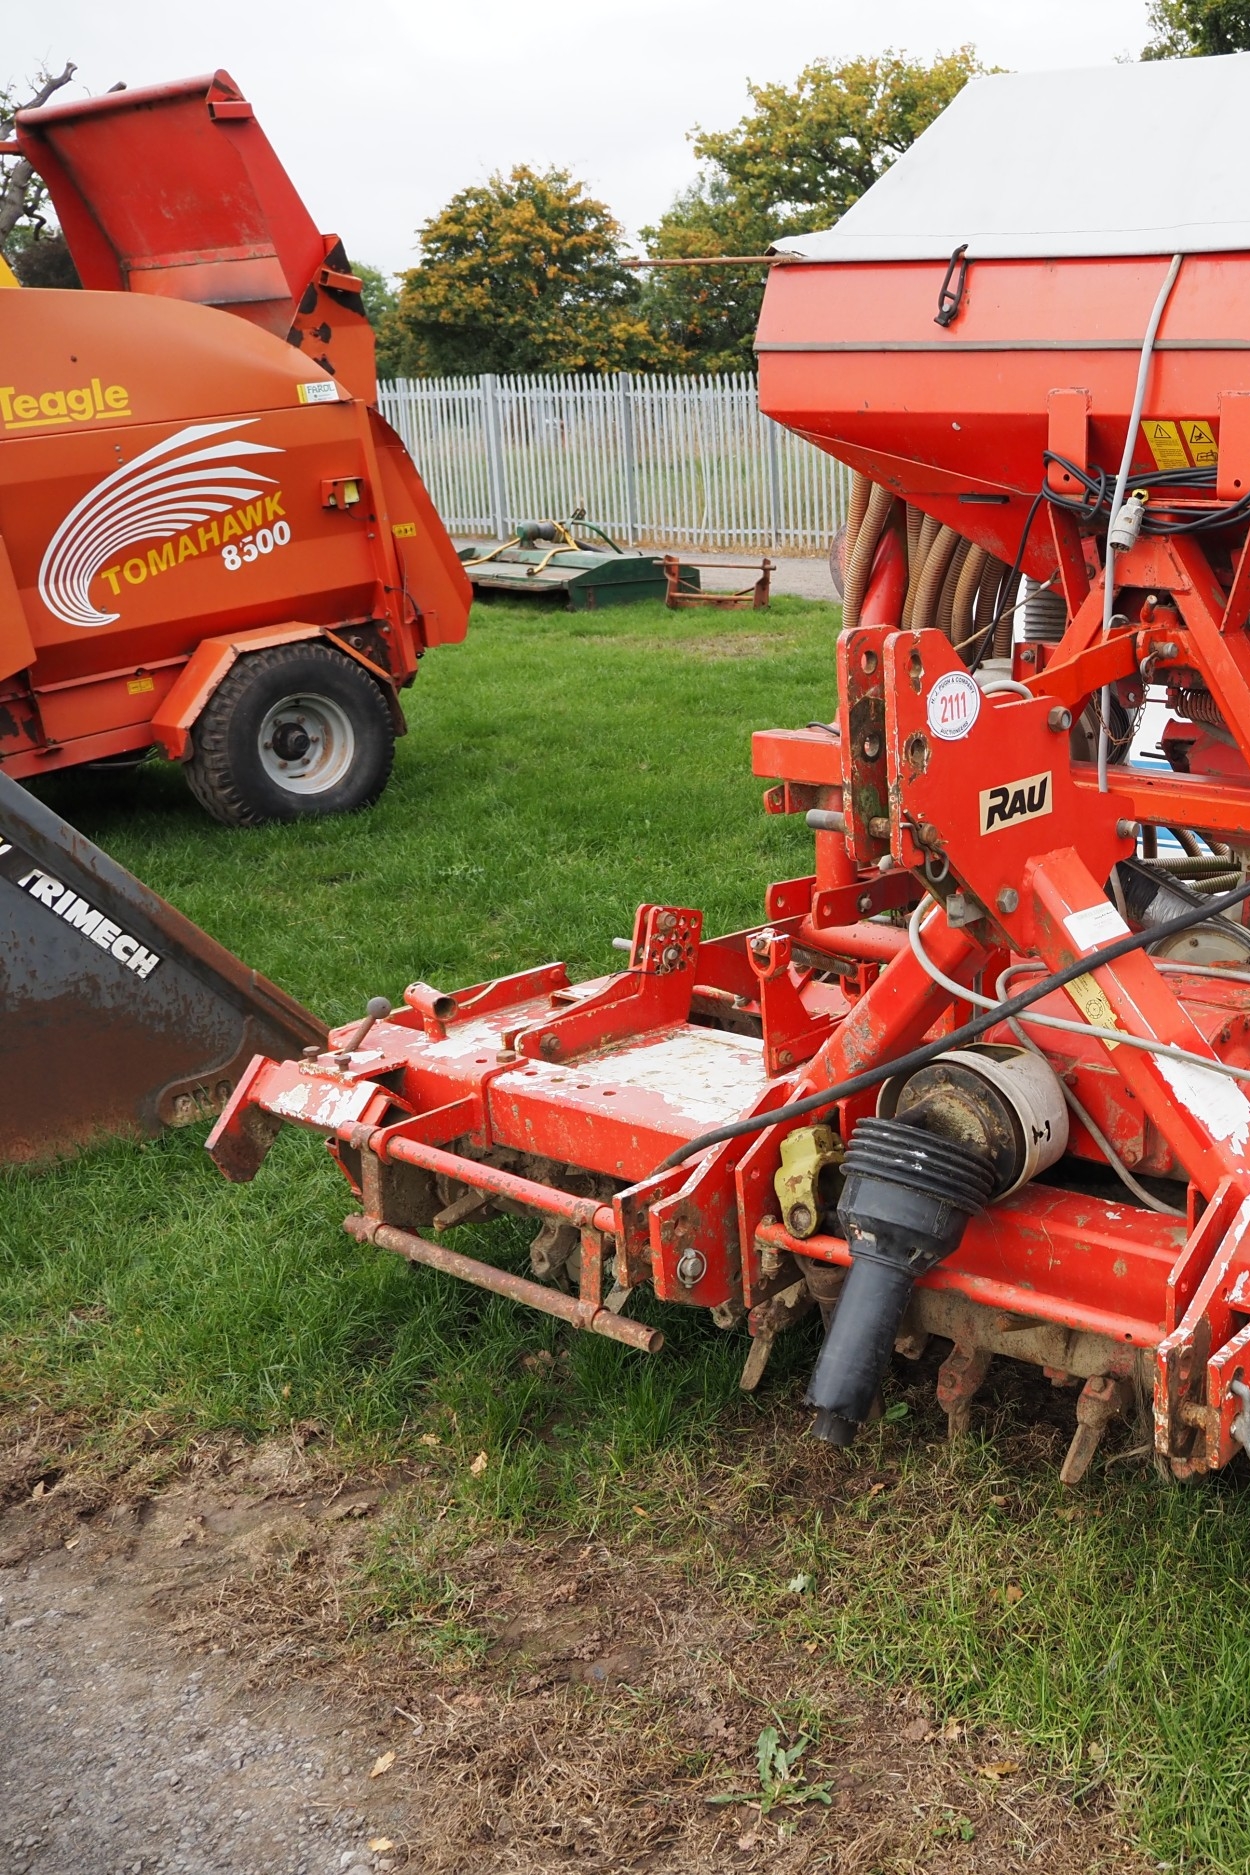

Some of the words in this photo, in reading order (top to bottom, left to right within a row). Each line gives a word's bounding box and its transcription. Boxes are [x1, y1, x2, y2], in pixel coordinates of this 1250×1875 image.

[0, 378, 129, 421] Teagle
[101, 490, 286, 596] TOMAHAWK
[221, 520, 291, 571] 8500
[940, 691, 967, 724] 2111
[986, 775, 1048, 832] RAU
